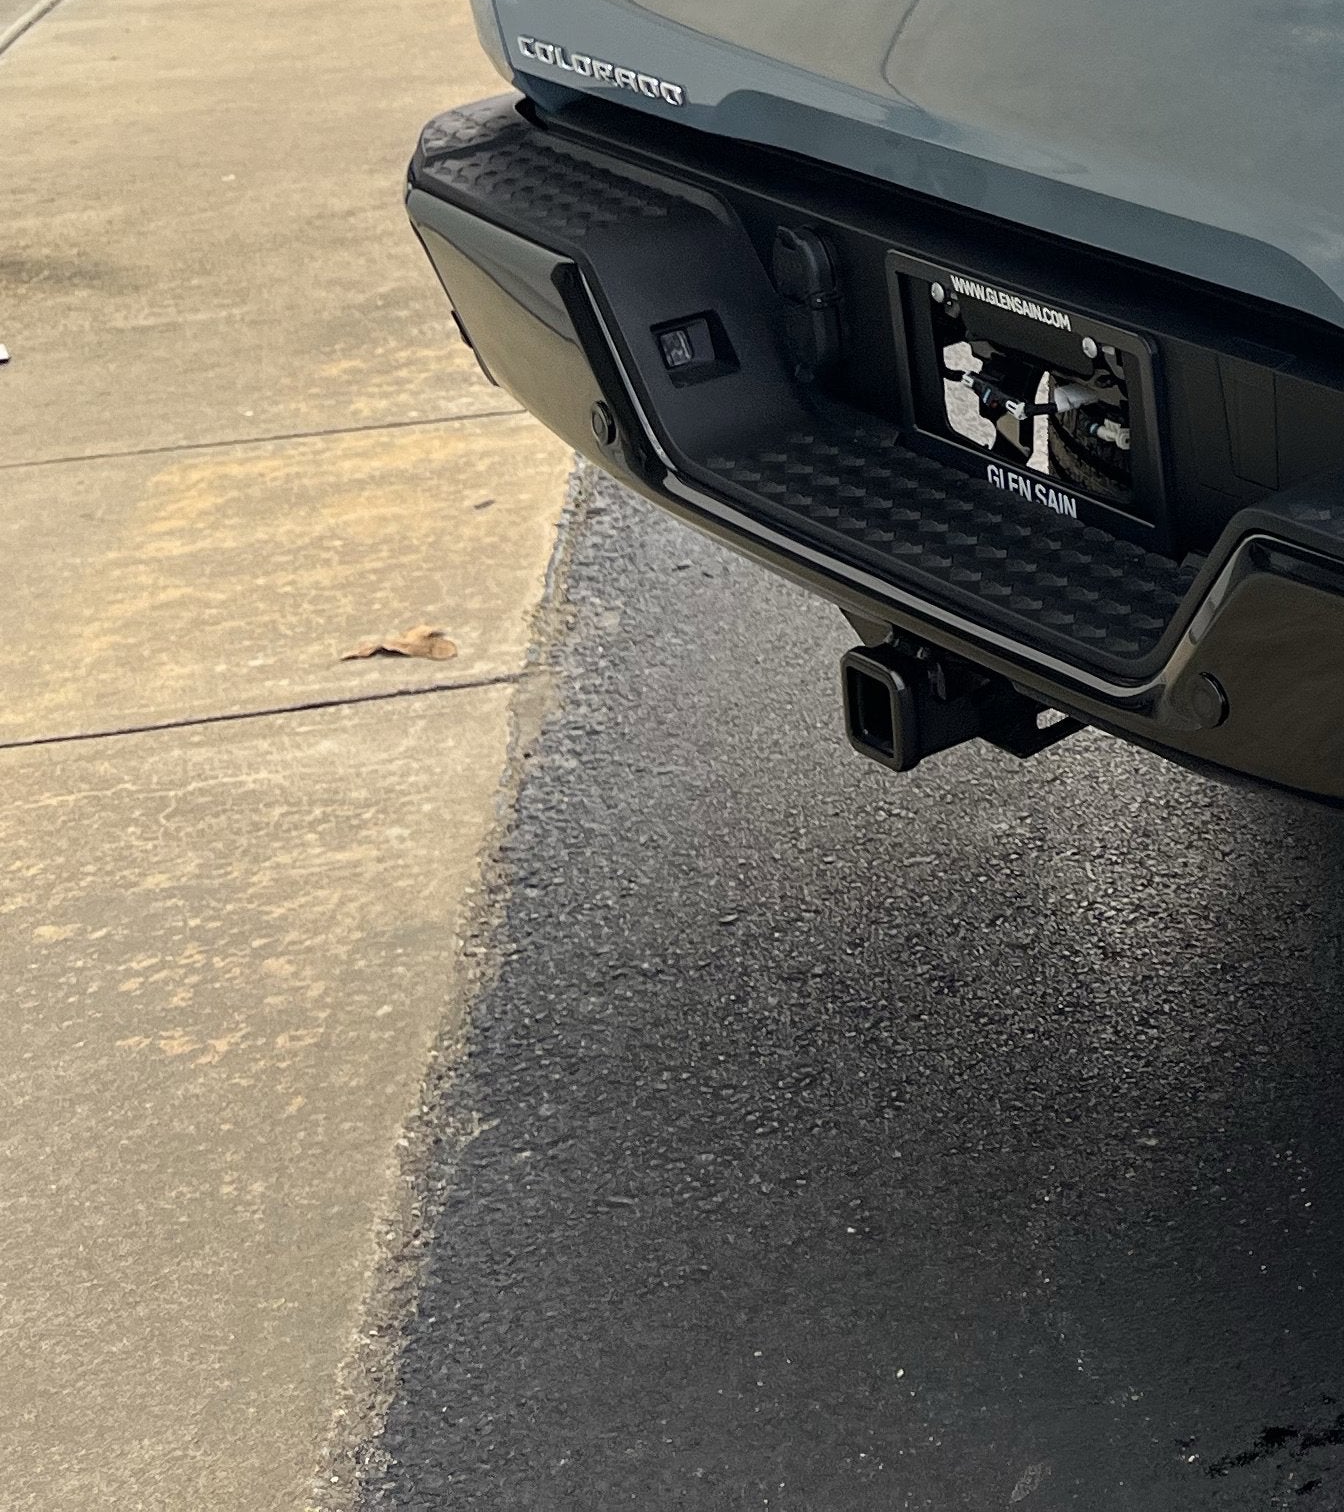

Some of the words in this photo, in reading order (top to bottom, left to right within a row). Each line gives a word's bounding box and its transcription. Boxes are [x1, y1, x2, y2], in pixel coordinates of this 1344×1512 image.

[517, 35, 685, 106] COLORADO
[950, 275, 1072, 332] WWW.GLENSAIN.COM
[1034, 483, 1077, 519] SAIN
